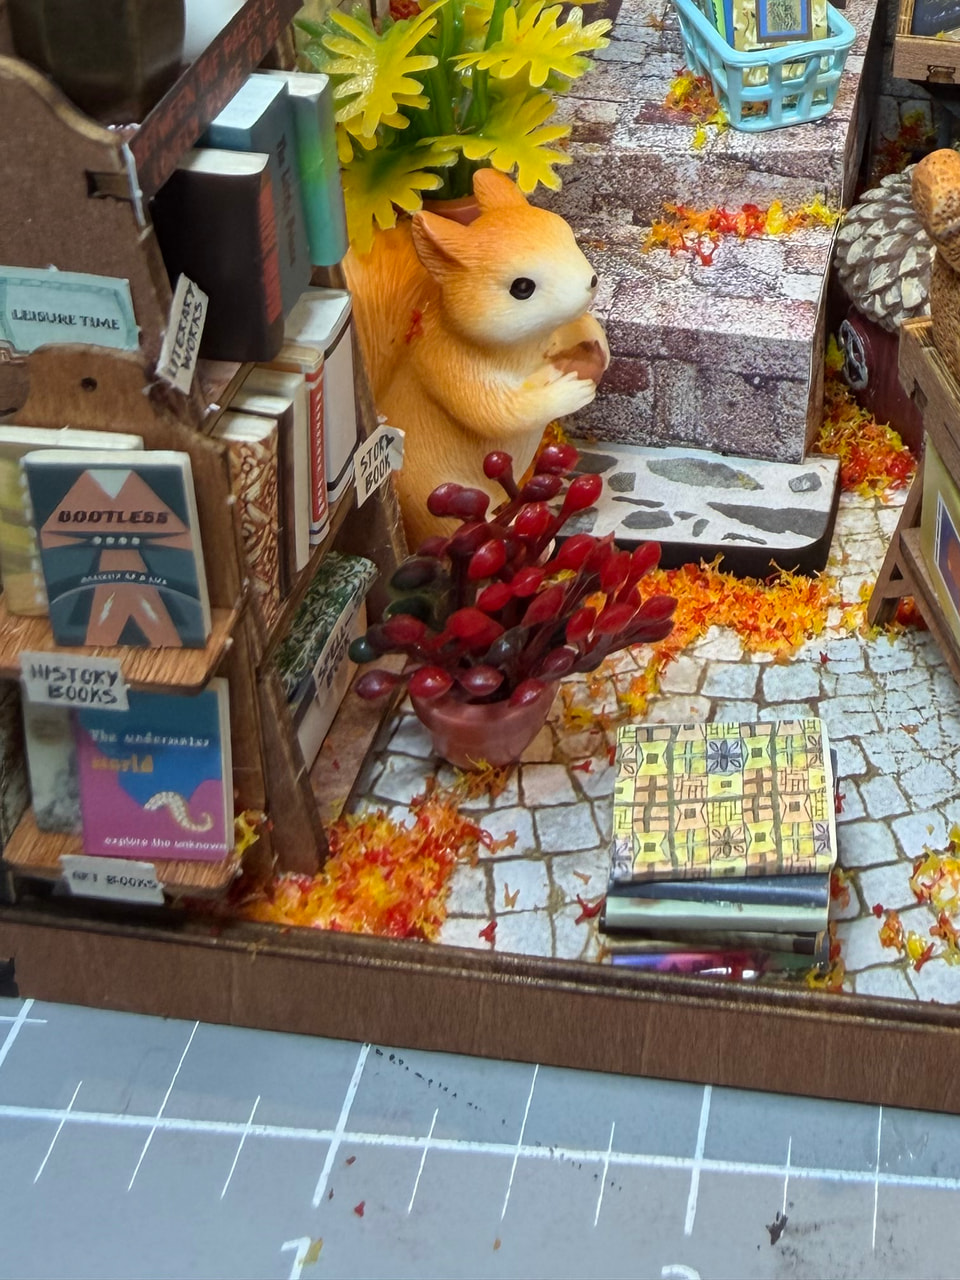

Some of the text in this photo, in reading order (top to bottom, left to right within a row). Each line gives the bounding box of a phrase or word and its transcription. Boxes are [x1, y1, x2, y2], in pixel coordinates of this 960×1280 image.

[79, 312, 121, 331] TIME
[180, 299, 204, 373] WORKS
[360, 432, 395, 473] STORY
[364, 457, 392, 495] BOOK
[58, 509, 170, 524] BOOTLESS
[30, 663, 118, 685] HISTORY
[47, 683, 118, 705] BOOKS
[90, 729, 117, 743] The
